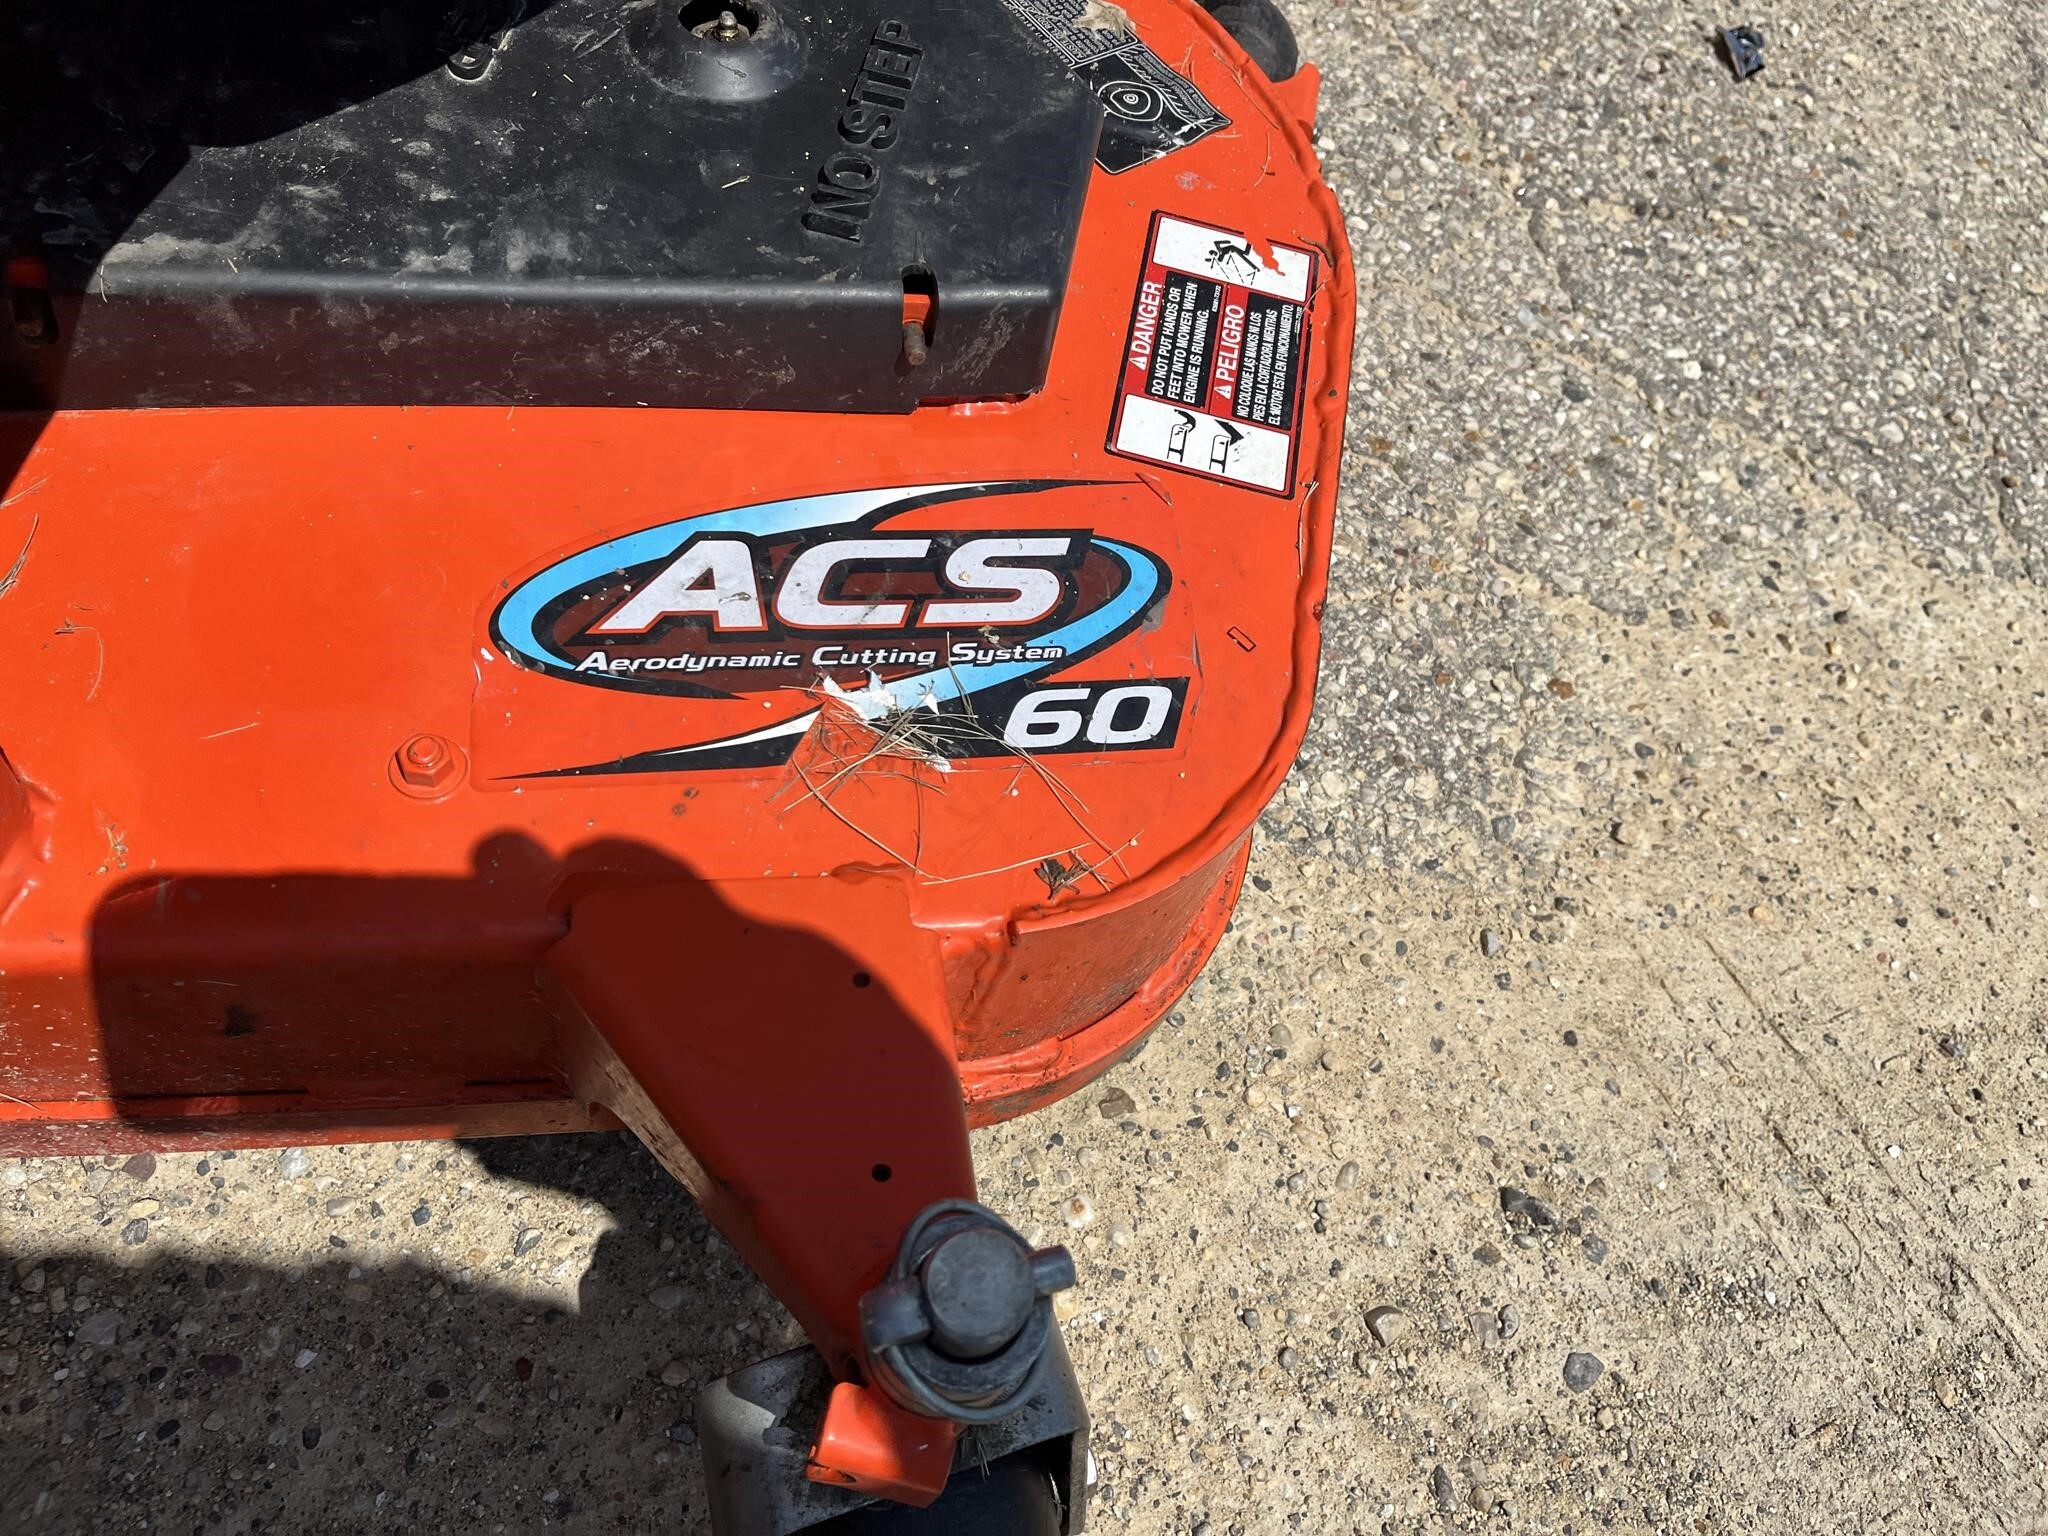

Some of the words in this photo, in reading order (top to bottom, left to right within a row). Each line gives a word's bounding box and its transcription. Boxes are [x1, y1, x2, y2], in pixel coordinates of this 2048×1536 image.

[838, 18, 924, 150] STEP
[1168, 286, 1182, 304] OR
[1182, 282, 1198, 311] WHEN
[1130, 281, 1162, 355] DANGER
[1162, 302, 1179, 336] HANDS
[1176, 311, 1194, 348] MOWER
[1191, 309, 1210, 354] RUNNING.
[1249, 311, 1262, 326] LOS
[1262, 309, 1278, 343] MIENTRAS
[1158, 335, 1173, 357] PUT
[1215, 304, 1245, 382] PELIGRO
[1244, 333, 1259, 358] MANOS
[1154, 356, 1169, 379] NOT
[1171, 346, 1187, 374] INTO
[1189, 353, 1202, 366] IS
[1243, 356, 1257, 372] LAS
[1258, 343, 1274, 383] CORTADORA
[1275, 361, 1287, 371] EN
[1151, 379, 1165, 395] DO
[1167, 371, 1182, 400] FEET
[1183, 365, 1200, 404] ENGINE
[1238, 371, 1254, 406] COLOQUE
[1254, 391, 1267, 405] EN
[1256, 380, 1269, 392] LA
[1236, 405, 1249, 418] NO
[1252, 405, 1266, 422] PIES
[1269, 389, 1285, 415] MOTOR
[1268, 413, 1281, 426] EL
[598, 537, 1072, 632] ACS
[575, 651, 800, 672] Aerodynamic
[812, 645, 936, 667] Cutting
[950, 641, 1065, 664] System
[1003, 686, 1173, 749] 60
